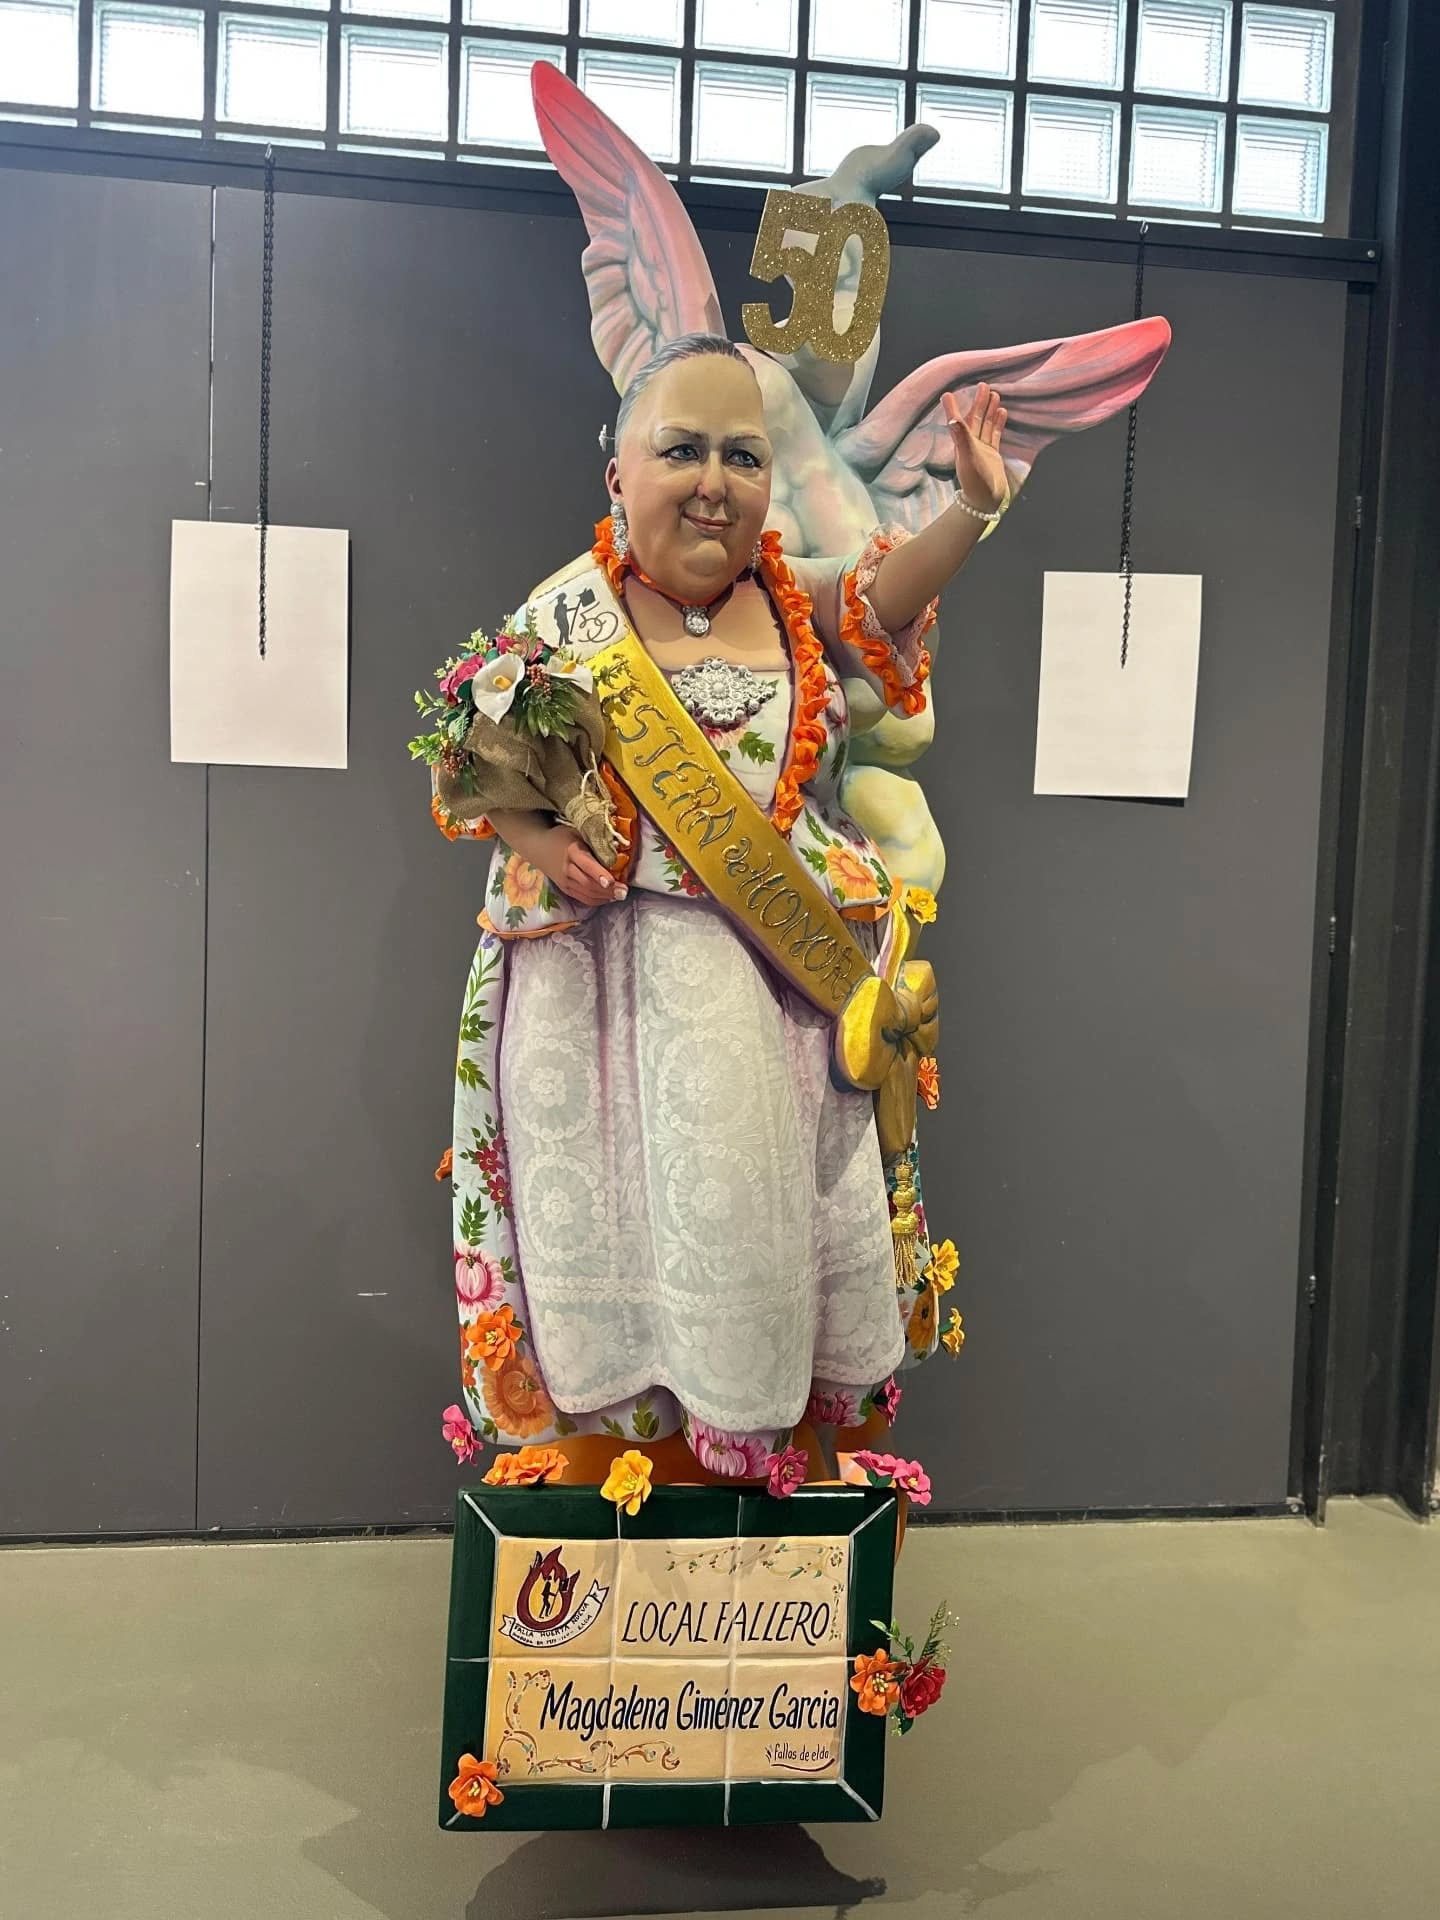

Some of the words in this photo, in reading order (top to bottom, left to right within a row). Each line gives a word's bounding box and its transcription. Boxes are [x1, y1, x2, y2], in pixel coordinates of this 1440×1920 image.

[742, 188, 891, 364] 50
[578, 601, 619, 643] 50
[736, 852, 859, 1001] HONOR
[540, 1624, 570, 1637] HUERTA
[621, 1601, 708, 1646] LOCAL
[713, 1601, 830, 1646] FALLERO
[540, 1680, 669, 1741] Magdalena
[676, 1680, 765, 1730] Giménez
[768, 1683, 838, 1730] Garcia
[800, 1744, 810, 1761] de
[811, 1743, 829, 1761] elda
